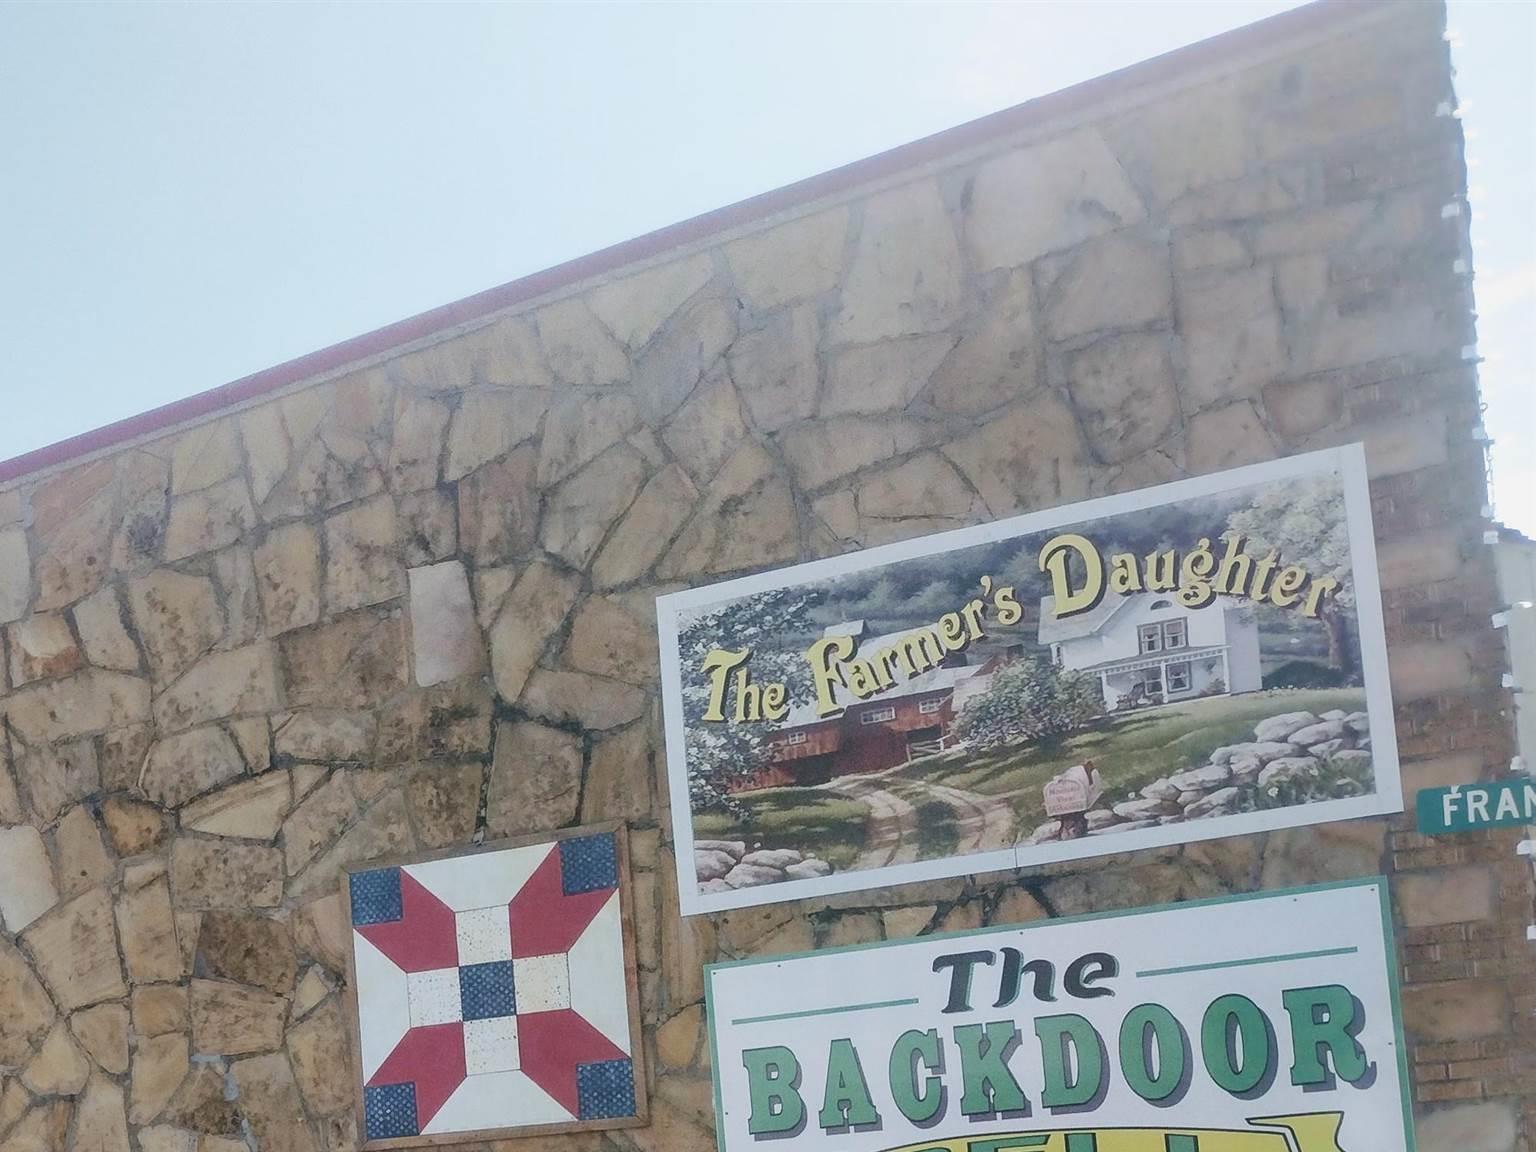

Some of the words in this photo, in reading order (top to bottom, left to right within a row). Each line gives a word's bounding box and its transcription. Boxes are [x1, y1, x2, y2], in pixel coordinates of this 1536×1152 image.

[700, 647, 792, 723] The
[806, 575, 1023, 719] Farmer's
[1039, 533, 1343, 619] Daughter
[932, 946, 1120, 1014] The
[742, 984, 1376, 1138] BACKDOOR
